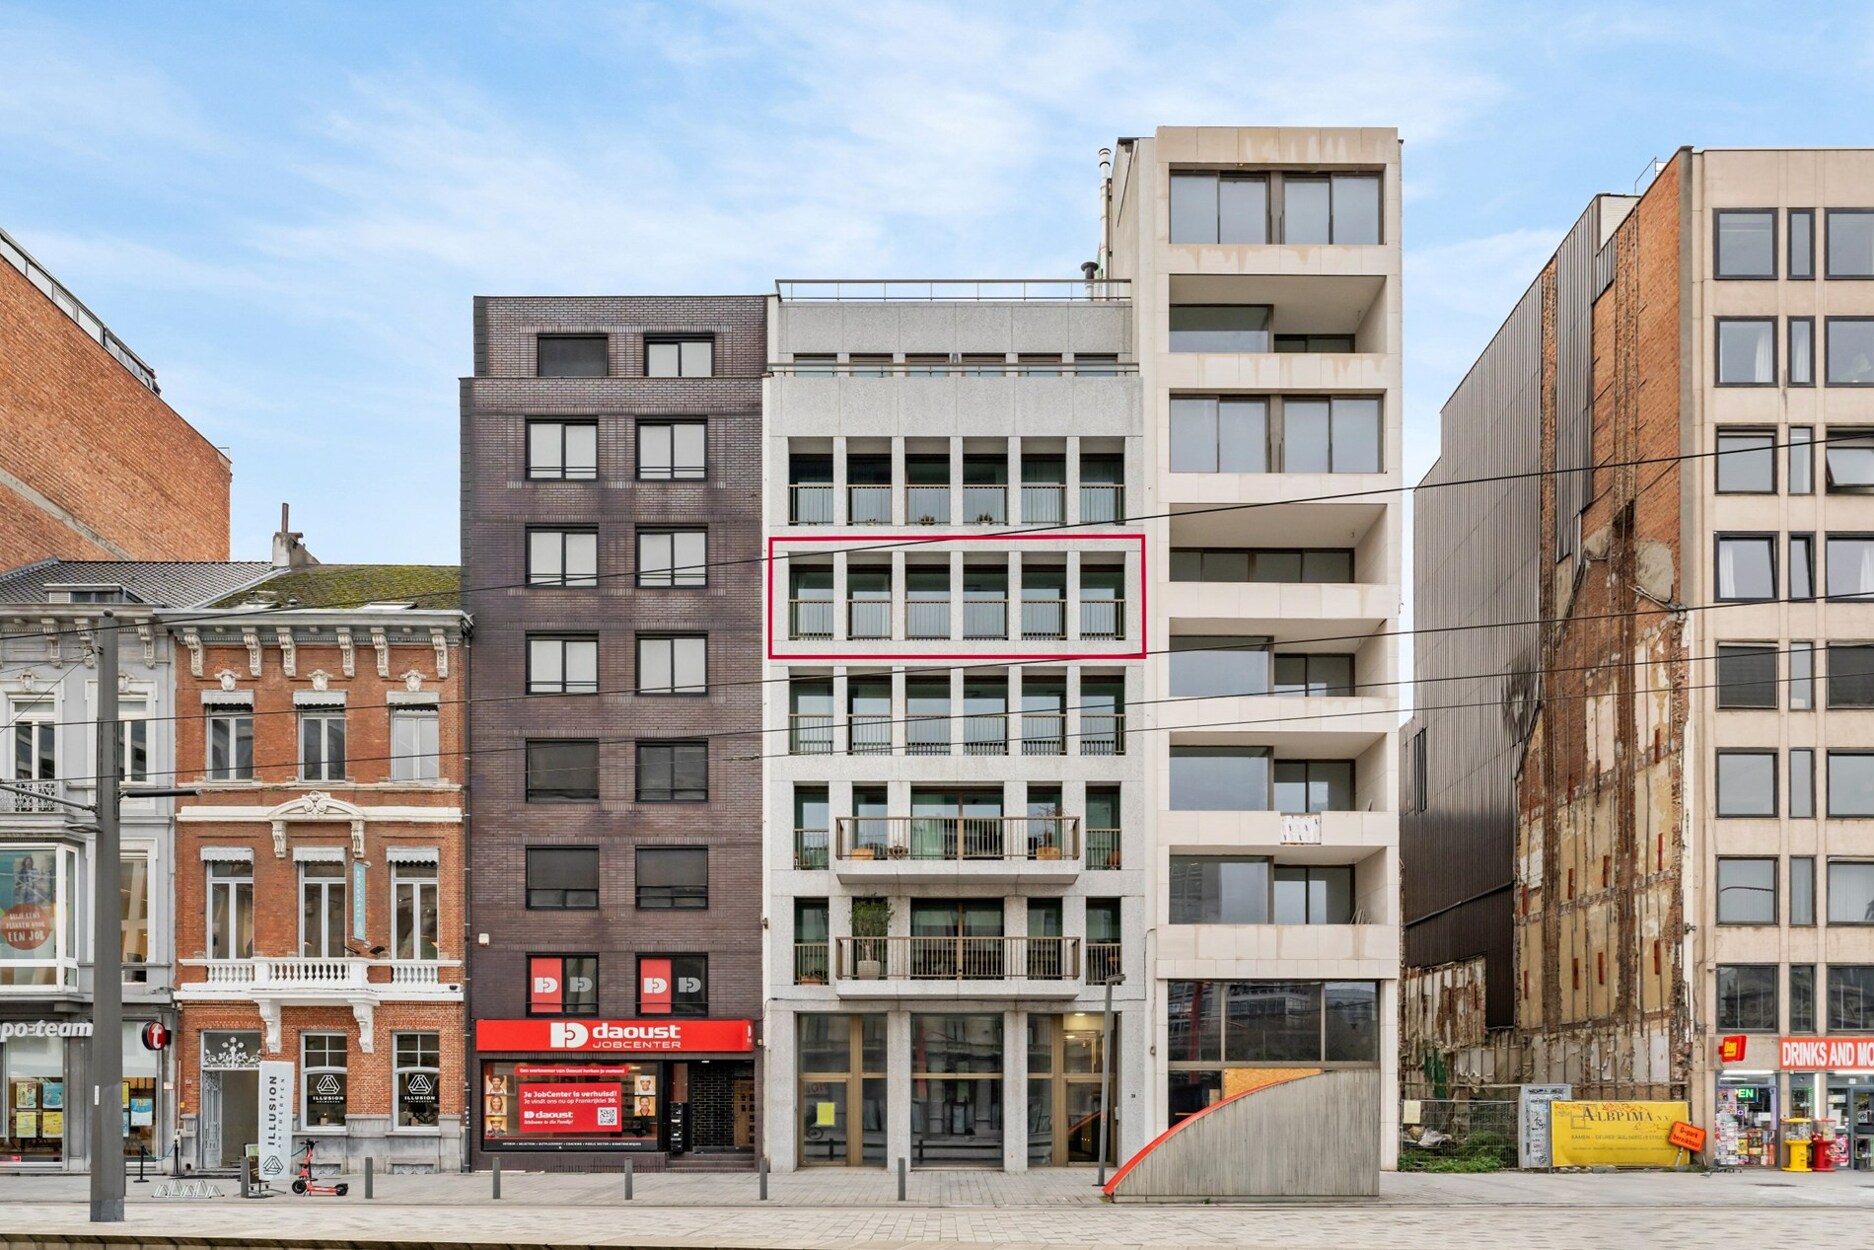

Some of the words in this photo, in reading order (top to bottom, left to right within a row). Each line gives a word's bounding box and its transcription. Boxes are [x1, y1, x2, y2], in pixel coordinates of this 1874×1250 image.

[8, 932, 26, 942] EEN
[592, 1024, 680, 1039] daoust
[1782, 1042, 1827, 1066] DRINKS
[1829, 1042, 1854, 1066] AND
[268, 1076, 277, 1146] ILLUSION
